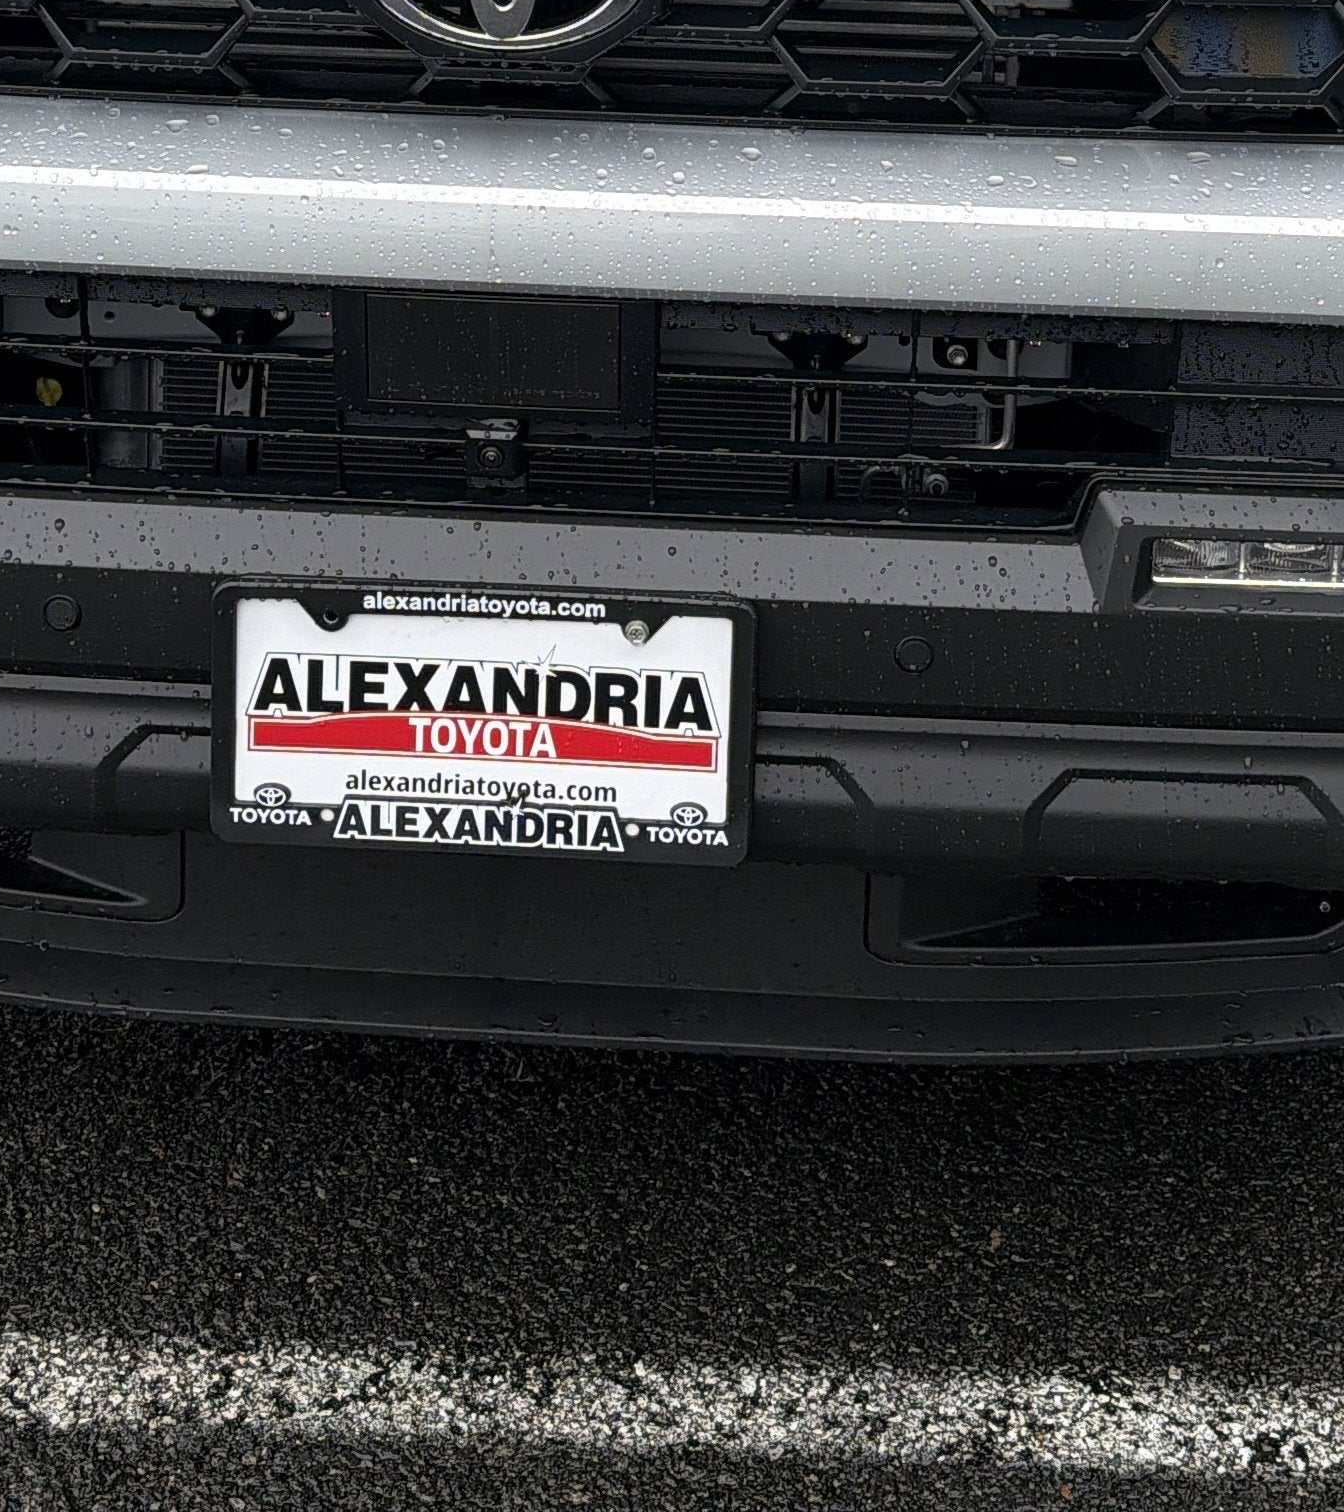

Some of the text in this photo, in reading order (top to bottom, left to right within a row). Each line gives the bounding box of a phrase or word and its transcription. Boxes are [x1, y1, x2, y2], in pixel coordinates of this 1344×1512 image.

[362, 591, 607, 618] alexandriatoyota.com
[251, 656, 716, 734] ALEXANDRIA
[408, 716, 558, 759] TOYOTA
[345, 769, 618, 803] alexandriatoyota.com
[229, 806, 312, 826] TOYOTA
[336, 801, 623, 851] ALEXANDRIA
[646, 826, 729, 847] TOYOTA
